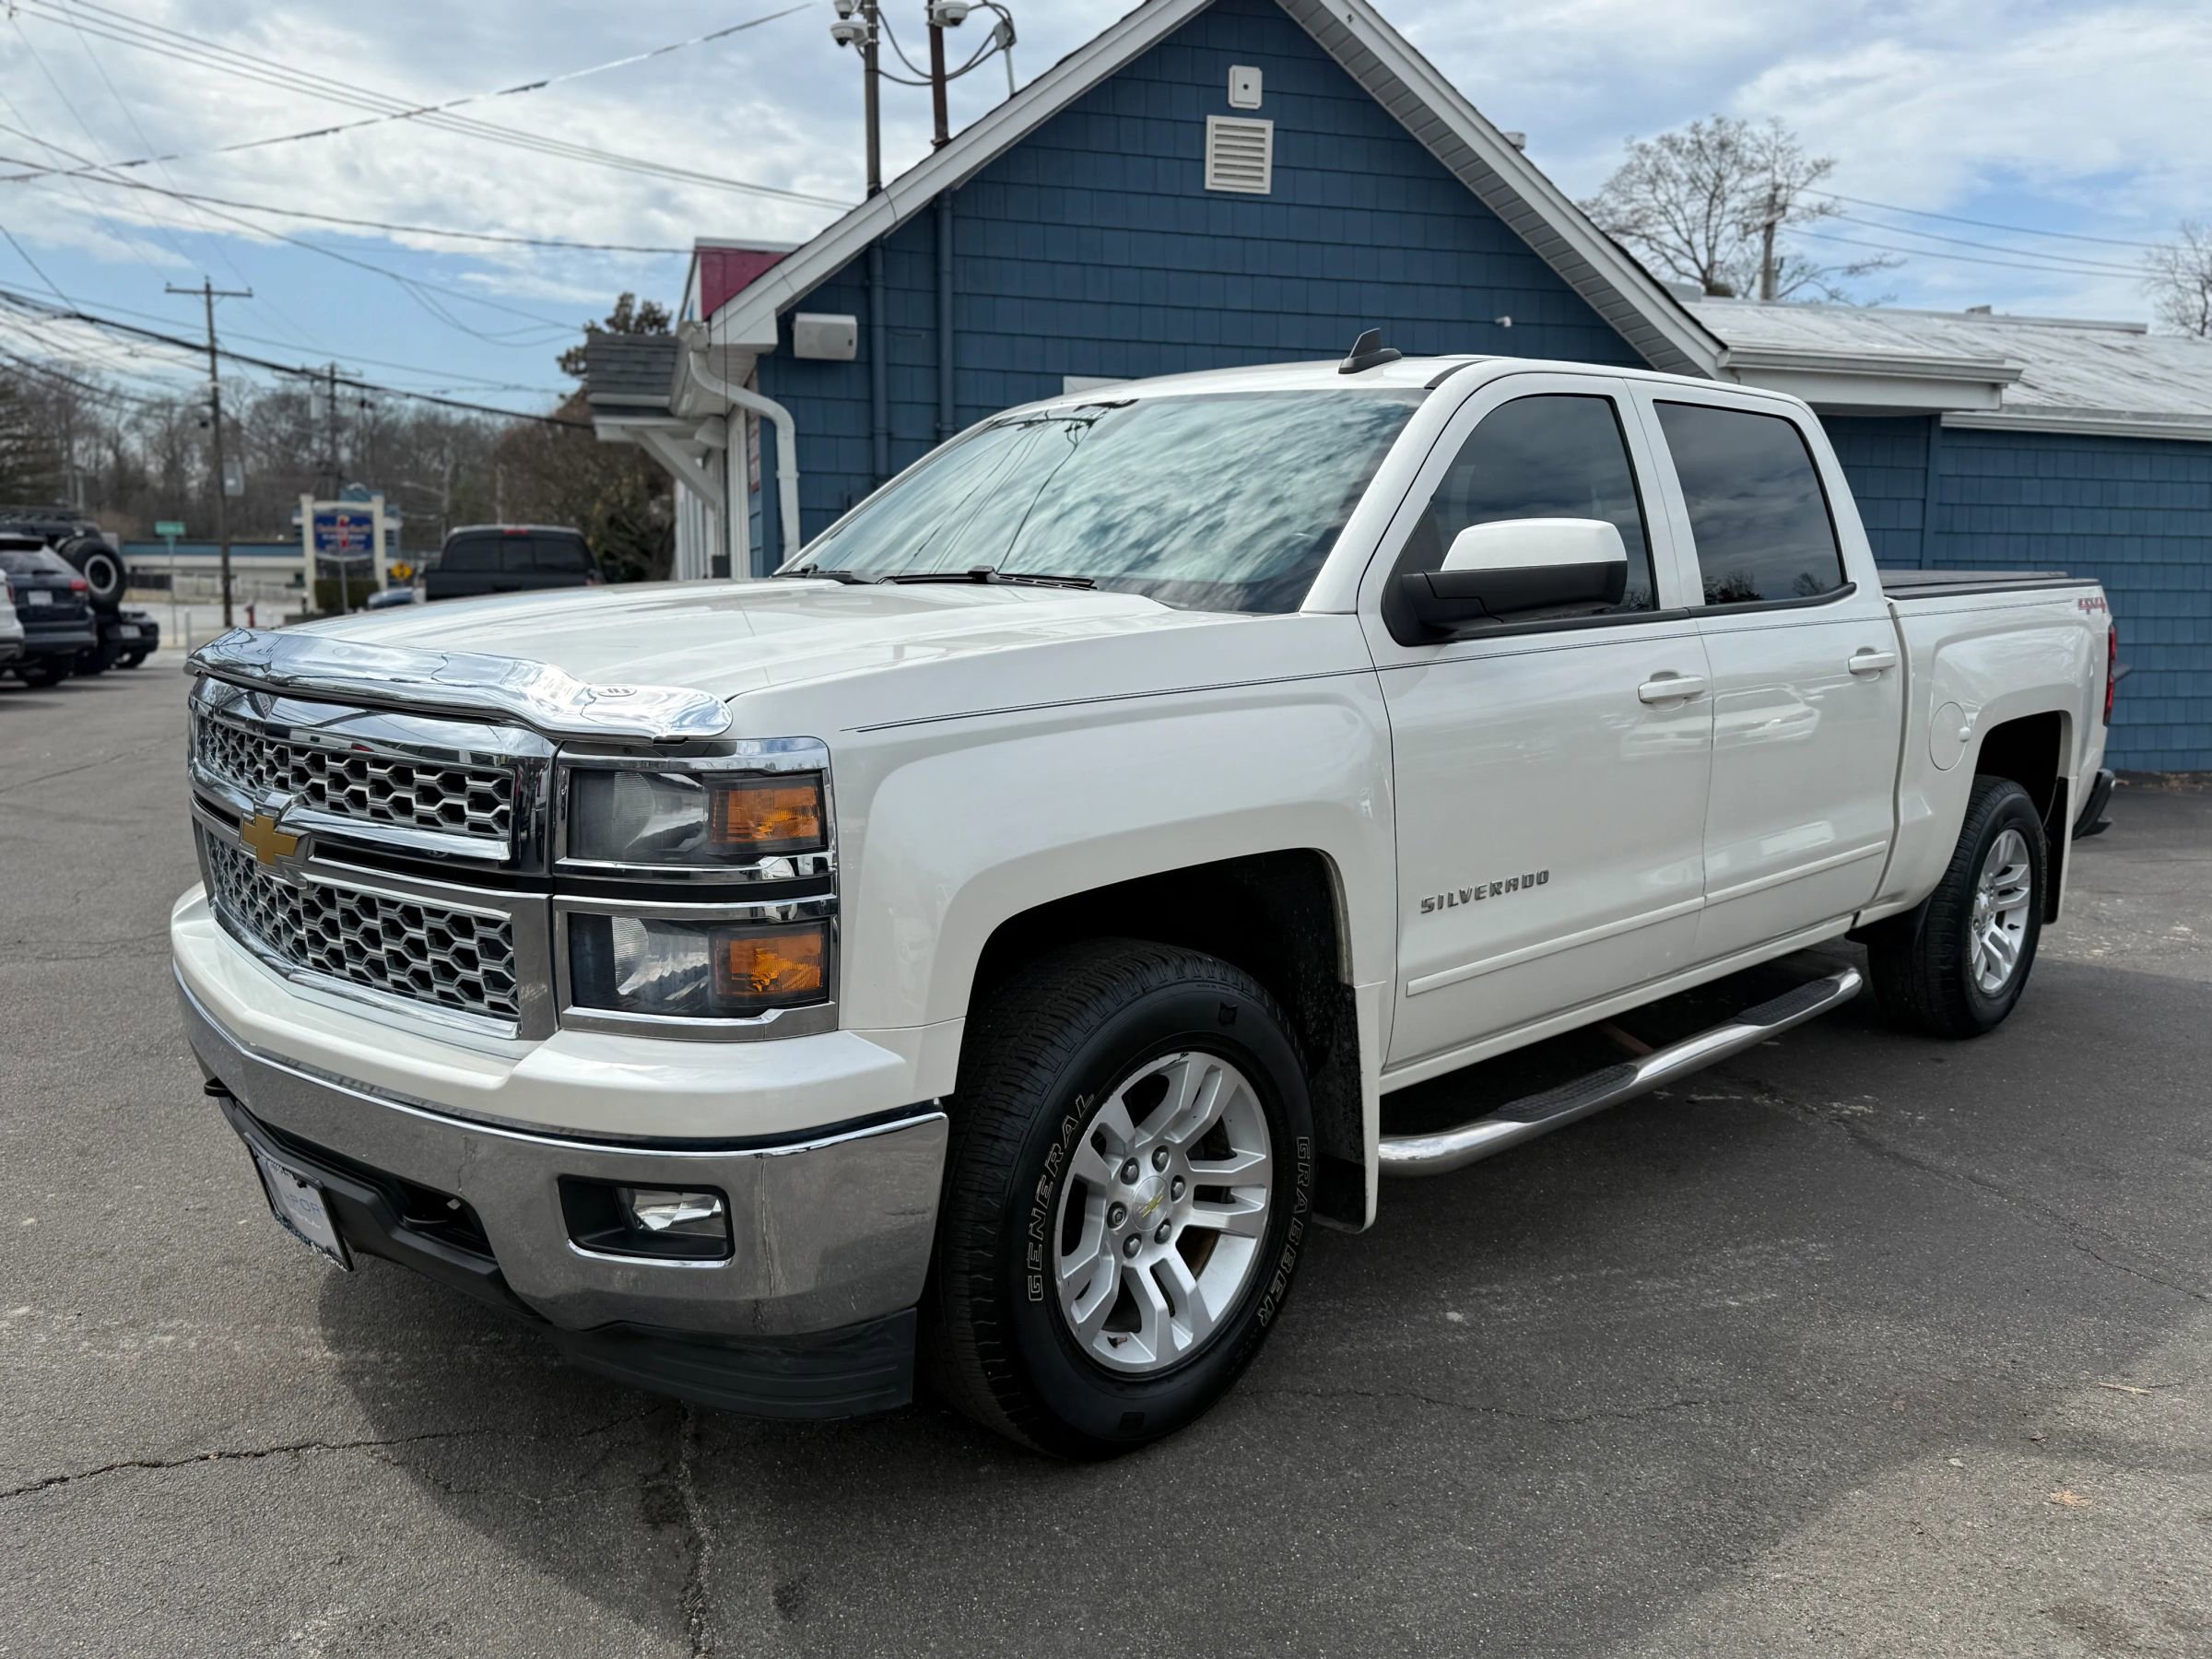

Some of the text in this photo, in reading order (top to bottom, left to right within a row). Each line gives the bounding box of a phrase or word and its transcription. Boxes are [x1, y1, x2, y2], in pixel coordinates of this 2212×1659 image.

[1420, 869, 1549, 914] SILVERADO
[1028, 1093, 1094, 1301] GENERAL
[1257, 1136, 1311, 1327] GRABBER
